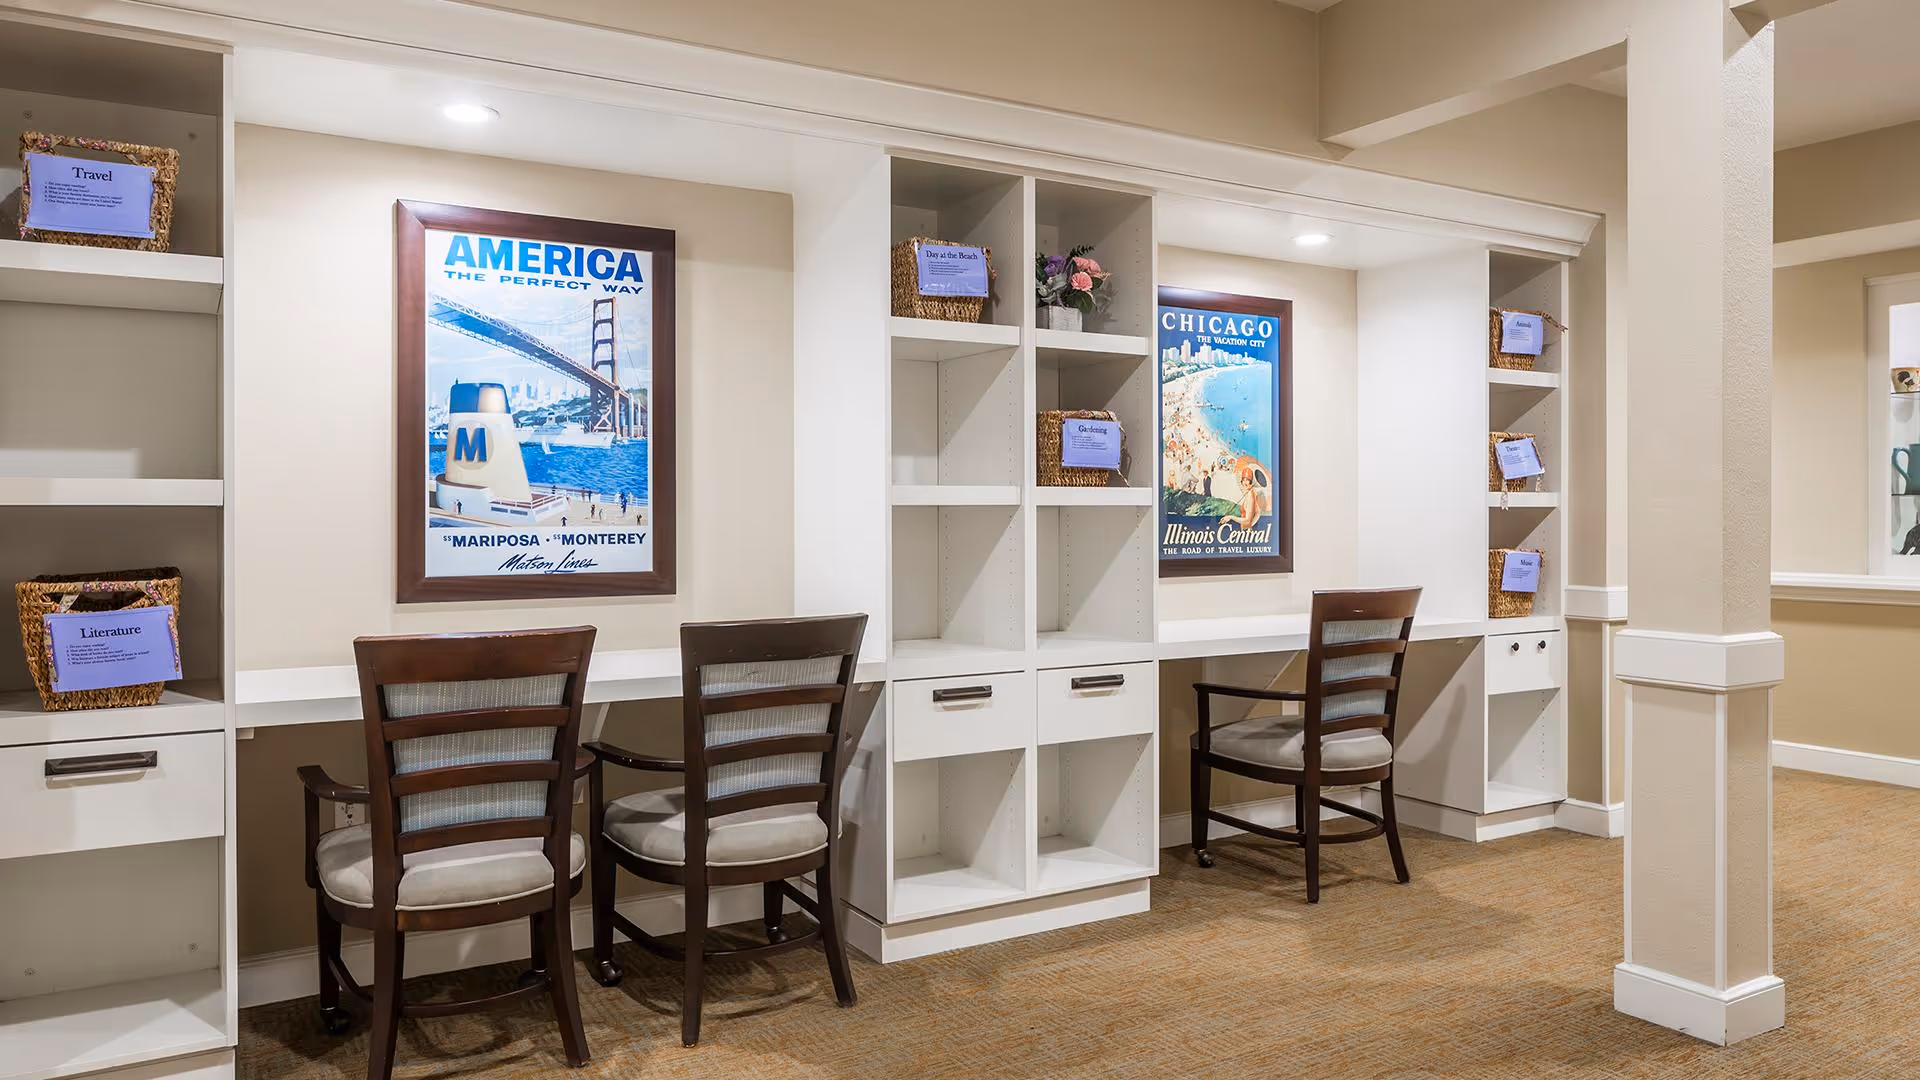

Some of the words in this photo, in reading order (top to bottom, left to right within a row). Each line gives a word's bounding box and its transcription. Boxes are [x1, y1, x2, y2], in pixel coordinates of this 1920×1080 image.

[72, 166, 112, 181] Travel
[444, 235, 644, 282] AMERICA
[925, 250, 939, 259] Day
[947, 250, 957, 259] the
[958, 252, 978, 260] Beach
[444, 270, 485, 281] THE
[500, 275, 591, 290] PERFECT
[602, 284, 644, 294] WAY
[1162, 312, 1272, 338] CHICAGO
[1196, 335, 1211, 343] THE
[1214, 336, 1247, 346] VACATION
[1249, 339, 1266, 348] CITY
[1078, 424, 1107, 435] Gardening
[453, 427, 487, 462] M
[452, 534, 540, 547] MARIPOSA
[561, 532, 646, 545] MONTEREY
[1163, 523, 1215, 544] Illinois
[1217, 523, 1272, 544] Central
[1218, 546, 1243, 554] TRAVEL
[497, 553, 553, 571] Matson
[544, 549, 598, 574] Lines
[80, 626, 142, 639] Literature
